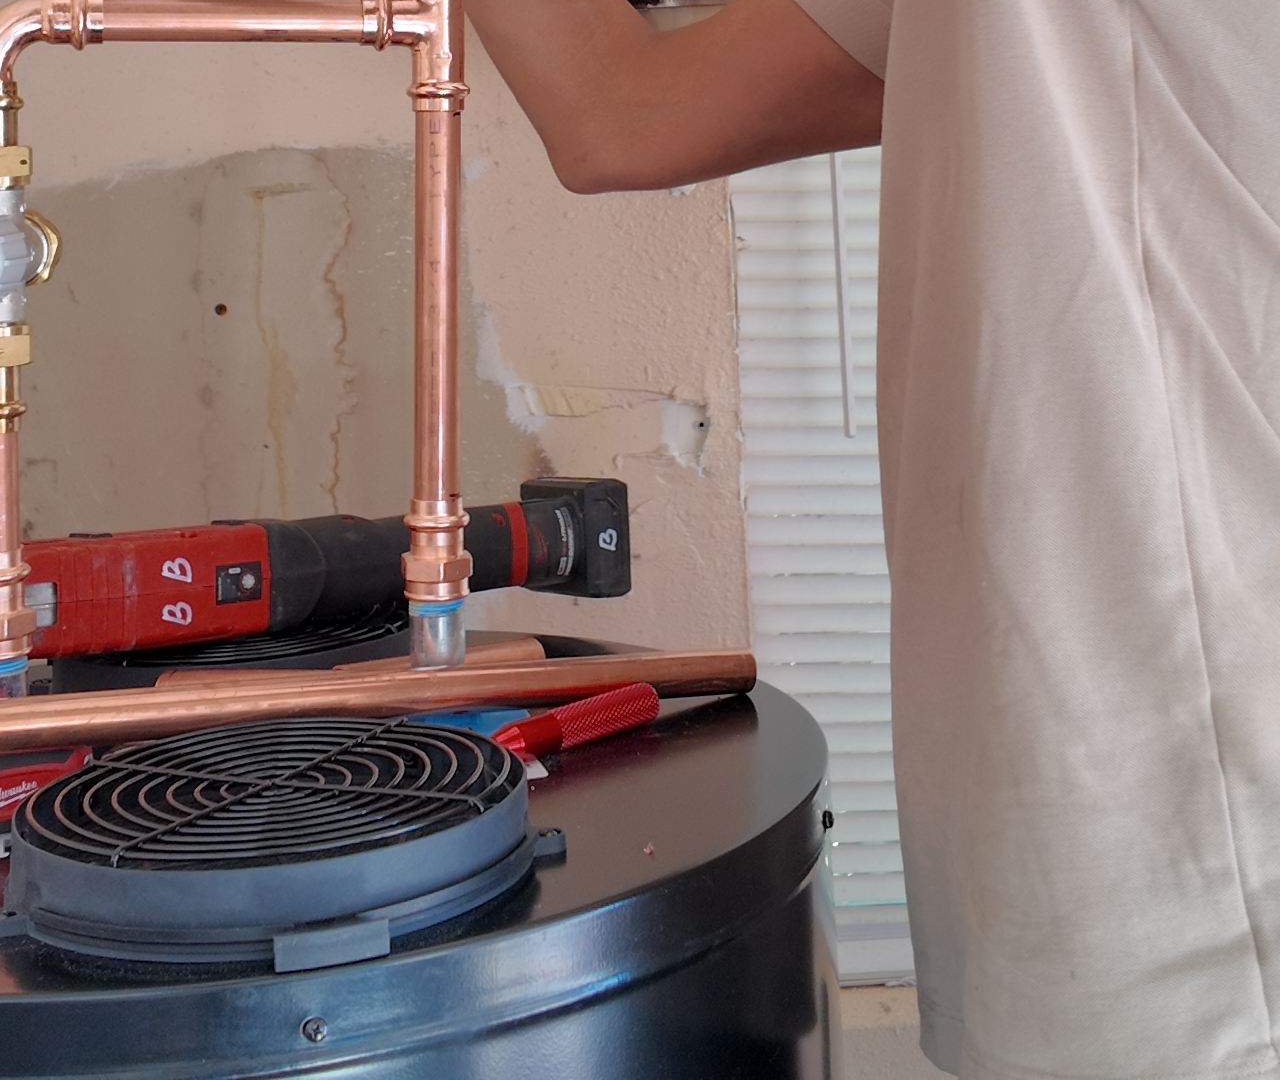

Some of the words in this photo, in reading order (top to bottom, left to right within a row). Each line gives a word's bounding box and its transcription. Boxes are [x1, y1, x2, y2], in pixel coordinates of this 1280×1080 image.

[428, 118, 442, 201] TYPE
[599, 527, 618, 551] B
[161, 556, 192, 583] B
[161, 601, 193, 626] B
